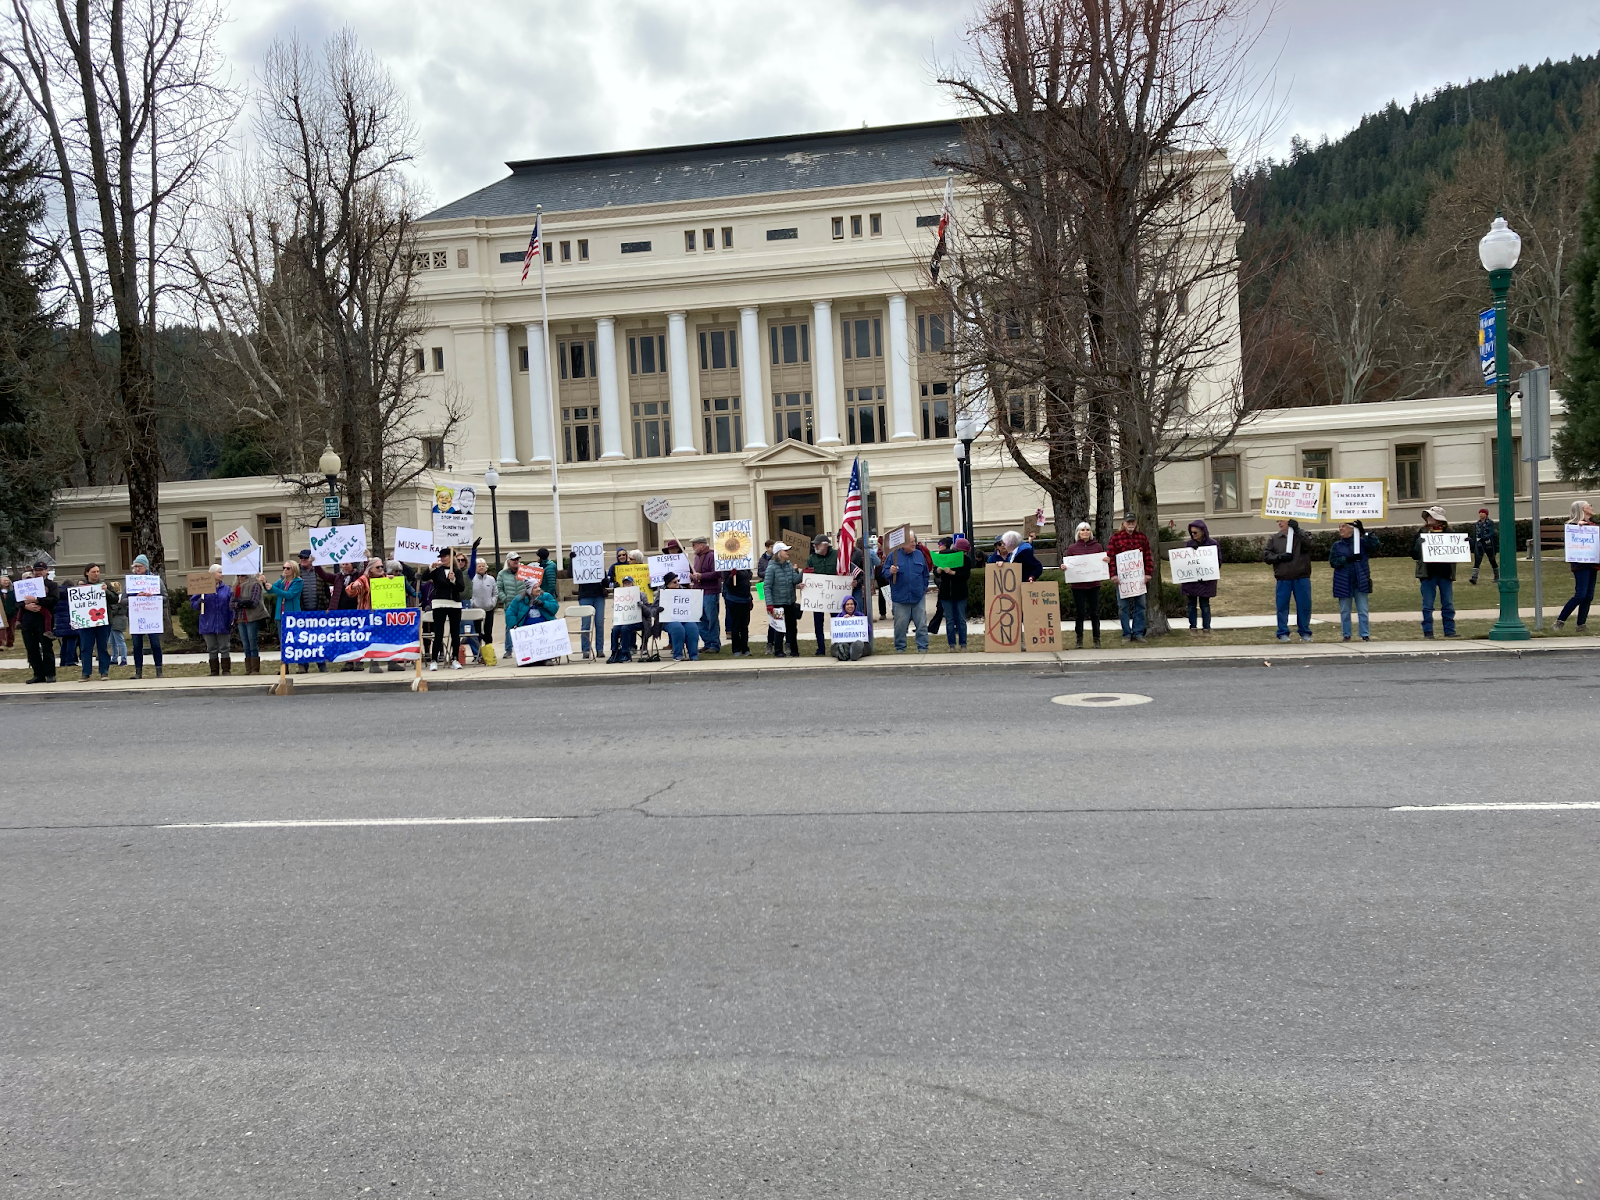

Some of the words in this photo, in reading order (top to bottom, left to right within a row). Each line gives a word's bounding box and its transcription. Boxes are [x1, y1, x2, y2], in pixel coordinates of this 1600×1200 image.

[1275, 481, 1300, 489] ARE
[1305, 483, 1315, 491] U
[1274, 490, 1296, 498] SCARED
[1267, 497, 1291, 509] STOP
[715, 519, 751, 532] SUPPORT
[222, 530, 239, 545] NOT
[785, 534, 810, 549] DEFEND
[1426, 534, 1444, 545] NOT
[329, 535, 358, 563] PEOPLE
[398, 540, 421, 551] MUSK
[572, 544, 603, 557] PROUD
[656, 554, 680, 563] RESPECT
[1117, 553, 1137, 563] ELECT
[1171, 550, 1191, 561] DACA
[1192, 548, 1213, 559] KIDS
[577, 558, 588, 566] to
[590, 557, 600, 566] be
[715, 557, 752, 570] DEMOCRACY
[573, 567, 603, 581] WOKE
[1119, 570, 1139, 581] EXPECT
[1176, 568, 1195, 578] OUR
[1196, 566, 1214, 576] KIDS
[371, 581, 405, 591] Democracy
[804, 577, 823, 589] Give
[825, 579, 852, 591] Thanks
[993, 568, 1017, 595] NO
[69, 586, 106, 602] Palestine
[673, 595, 690, 604] Fire
[820, 589, 834, 600] for
[1027, 590, 1039, 598] THE
[74, 601, 86, 609] Will
[615, 601, 636, 612] above
[803, 598, 823, 610] Rule
[826, 601, 836, 610] of
[71, 610, 91, 628] FREE
[285, 615, 366, 629] Democracy
[369, 613, 383, 626] Is
[385, 612, 417, 626] NOT
[622, 612, 638, 622] Law
[138, 622, 160, 631] KINGS
[284, 631, 295, 644] A
[297, 630, 372, 646] Spectator
[284, 645, 325, 661] Sport
